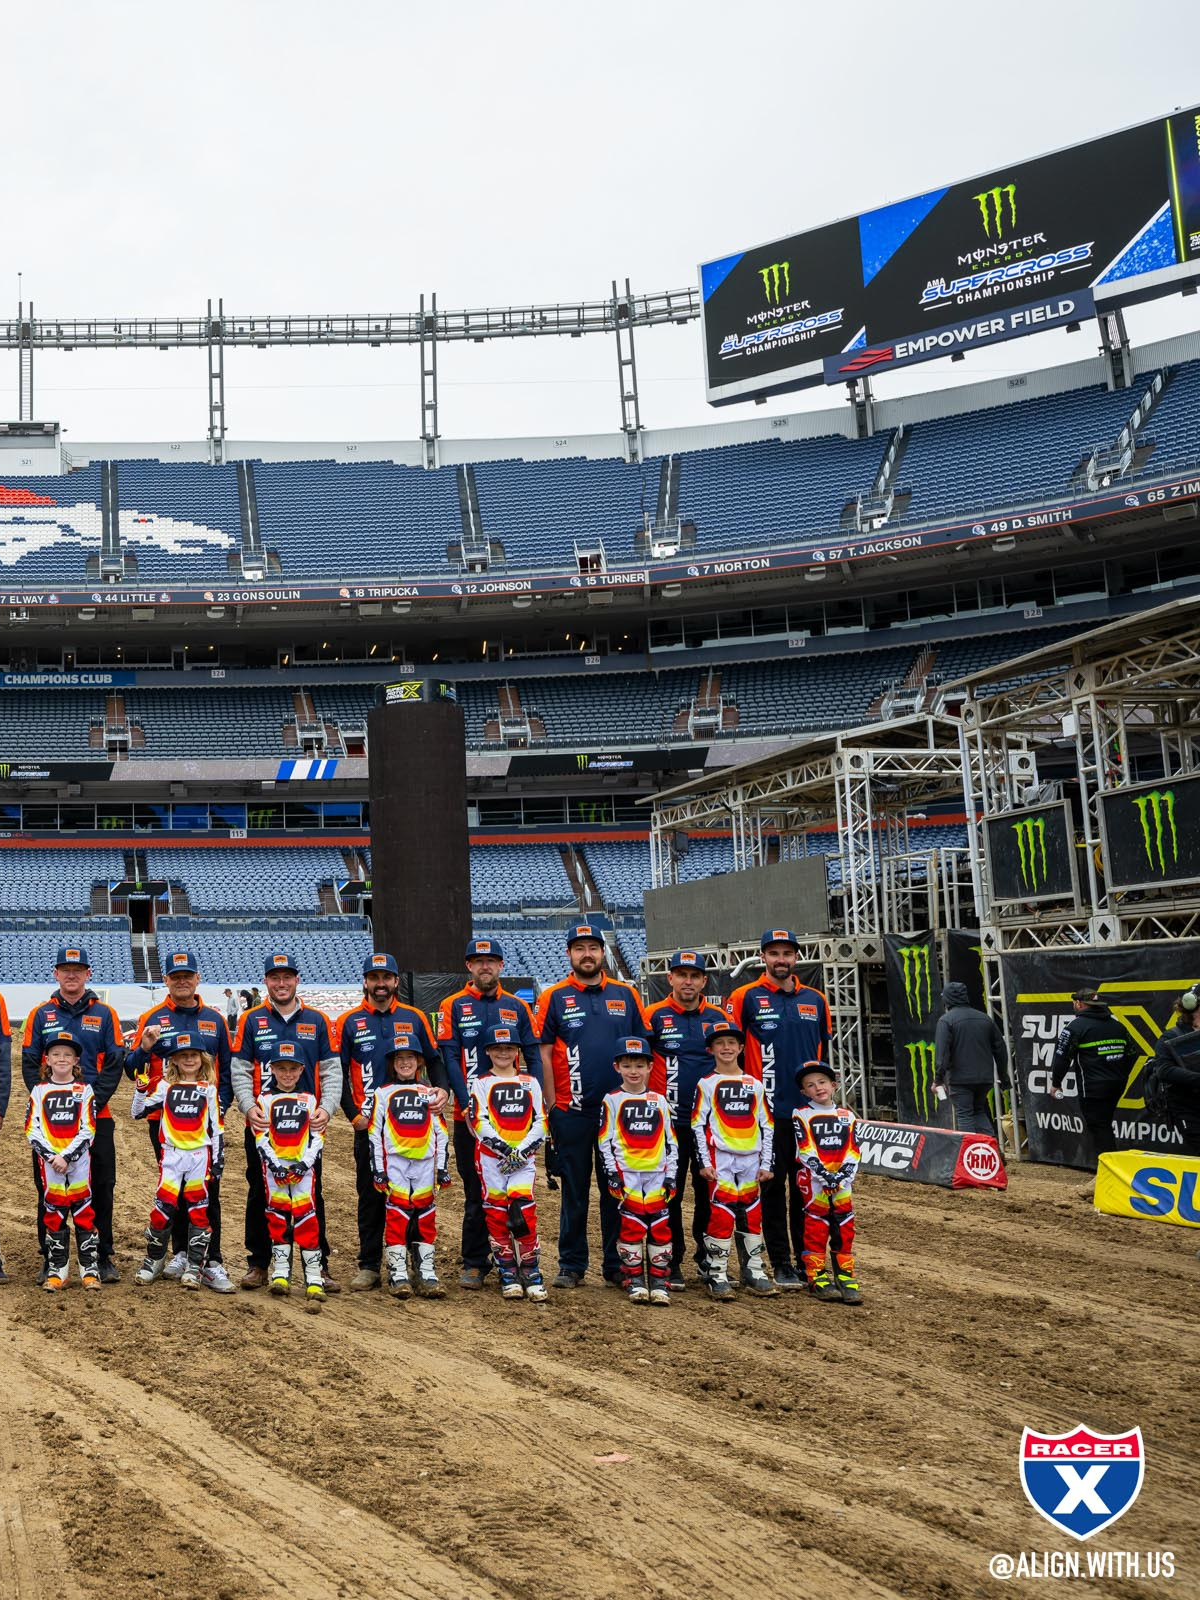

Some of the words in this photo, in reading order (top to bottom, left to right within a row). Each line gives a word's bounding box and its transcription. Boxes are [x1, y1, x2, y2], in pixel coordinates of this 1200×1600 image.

[957, 232, 1047, 266] MONSTER
[972, 248, 1033, 270] ENERGY
[918, 241, 1095, 304] SUPERCROSS
[926, 278, 946, 288] AMA
[957, 271, 1055, 304] CHAMPIONSHIP
[746, 300, 811, 325] MONSTER
[757, 312, 801, 328] ENERGY
[719, 308, 845, 354] SUPERCROSS
[895, 318, 1005, 358] EMPOWER
[1011, 300, 1075, 328] FIELD
[724, 334, 739, 342] AMA
[746, 329, 817, 355] CHAMPIONSHIP
[1147, 490, 1166, 502] 65
[990, 521, 1007, 532] 49
[1012, 519, 1024, 530] D.
[1027, 510, 1073, 527] SMITH
[828, 549, 843, 559] 57
[848, 547, 858, 557] T.
[859, 536, 922, 556] JACKSON
[703, 565, 710, 575] 7
[714, 558, 770, 574] MORTON
[585, 576, 597, 586] 15
[600, 573, 645, 585] TURNER
[354, 588, 365, 598] 18
[367, 587, 419, 597] TRIPUCKA
[465, 584, 478, 593] 12
[480, 580, 531, 593] JOHNSON
[0, 595, 6, 604] 7
[9, 595, 44, 604] ELWAY
[105, 594, 118, 603] 44
[120, 593, 156, 602] LITTLE
[217, 592, 230, 601] 23
[232, 590, 301, 601] GONSOULIN
[4, 674, 79, 685] CHAMPIONS
[81, 673, 113, 684] CLUB
[1021, 1015, 1077, 1039] SUP
[172, 1089, 200, 1101] TLD
[495, 1089, 524, 1100] TLD
[719, 1087, 747, 1099] TLD
[48, 1097, 74, 1109] TLD
[395, 1096, 423, 1107] TLD
[724, 1101, 750, 1111] KTM
[174, 1104, 199, 1114] KTM
[274, 1105, 302, 1116] TLD
[500, 1103, 524, 1113] KTM
[625, 1107, 654, 1119] TLD
[51, 1111, 74, 1121] KTM
[399, 1110, 423, 1120] KTM
[276, 1119, 300, 1129] KTM
[629, 1121, 652, 1131] KTM
[813, 1122, 843, 1134] TLD
[1035, 1112, 1084, 1134] WORLD
[856, 1123, 920, 1146] MOUNTAIN
[820, 1136, 842, 1146] KTM
[971, 1154, 994, 1170] RM
